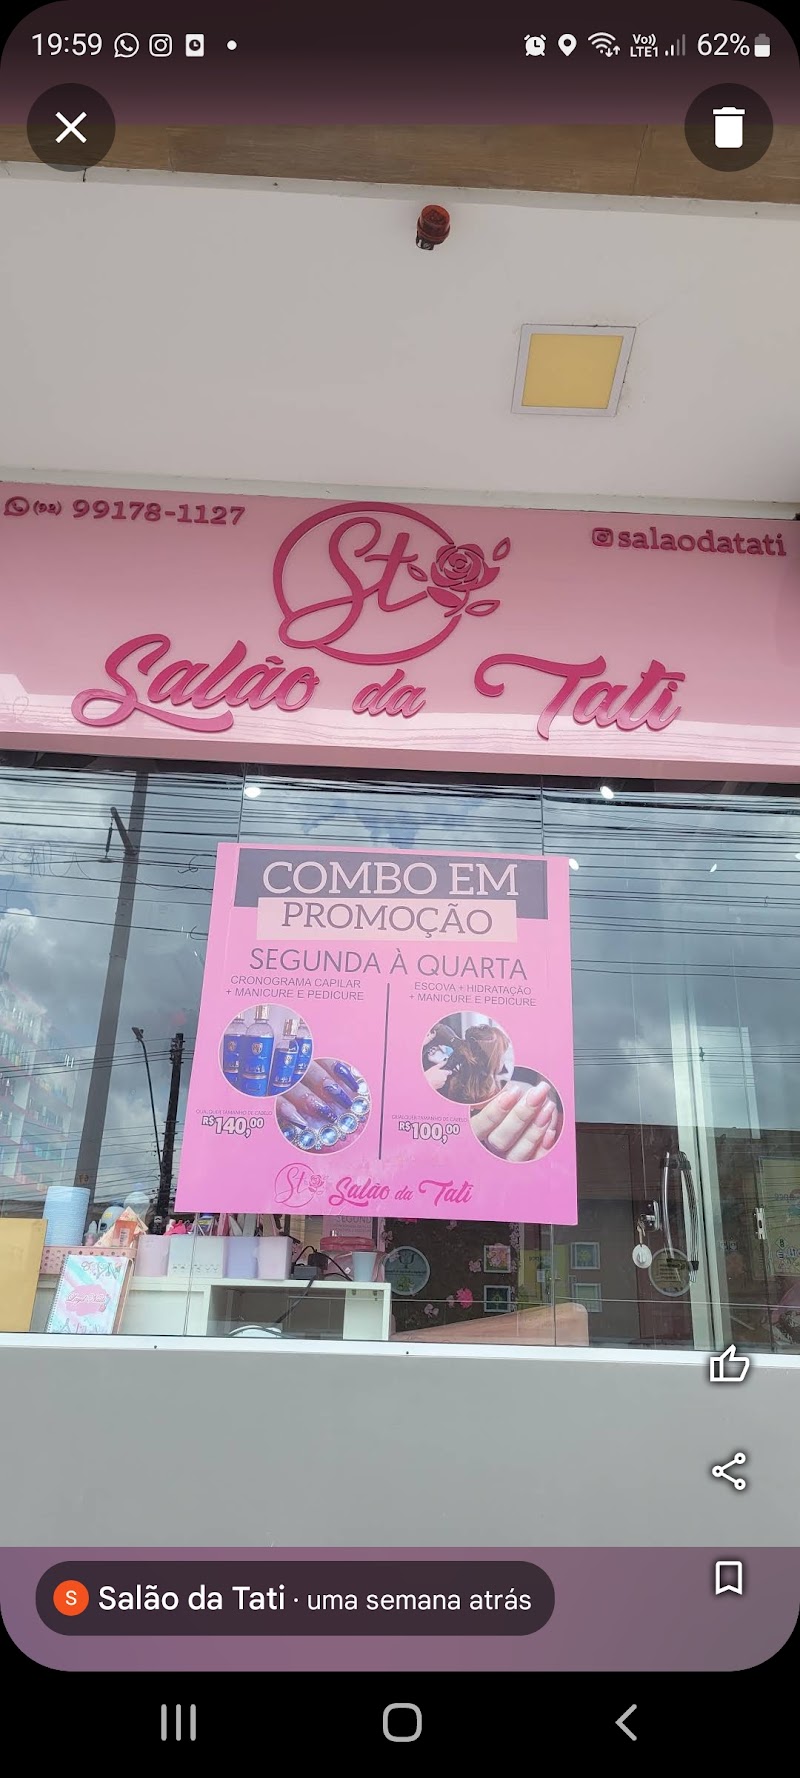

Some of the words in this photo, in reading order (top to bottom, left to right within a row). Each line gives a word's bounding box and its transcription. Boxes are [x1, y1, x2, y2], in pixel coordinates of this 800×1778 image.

[33, 500, 62, 516] (92)
[72, 499, 246, 525] 99178-1127
[617, 526, 787, 556] salaodatati
[71, 633, 320, 733] Salão
[352, 668, 426, 719] da
[474, 653, 686, 741] Tati
[262, 861, 438, 896] COMBO
[448, 863, 519, 896] EM
[281, 901, 494, 938] PROMOÇÃO
[249, 948, 381, 974] SEGUNDA
[389, 948, 408, 975] À
[417, 954, 528, 980] QUARTA
[230, 975, 312, 987] CRONOGRAMA
[314, 978, 361, 988] CAPILAR
[235, 987, 294, 998] MANICURE
[297, 989, 304, 998] E
[307, 990, 364, 1000] PEDICURE
[414, 981, 456, 992] ESCOVA
[466, 984, 532, 997] HIDRATAÇÃO
[417, 993, 472, 1004] MANICURE
[474, 995, 482, 1004] E
[484, 996, 537, 1006] PEDICURE
[328, 1176, 391, 1207] Salão
[395, 1185, 413, 1201] da
[418, 1179, 474, 1207] Tati
